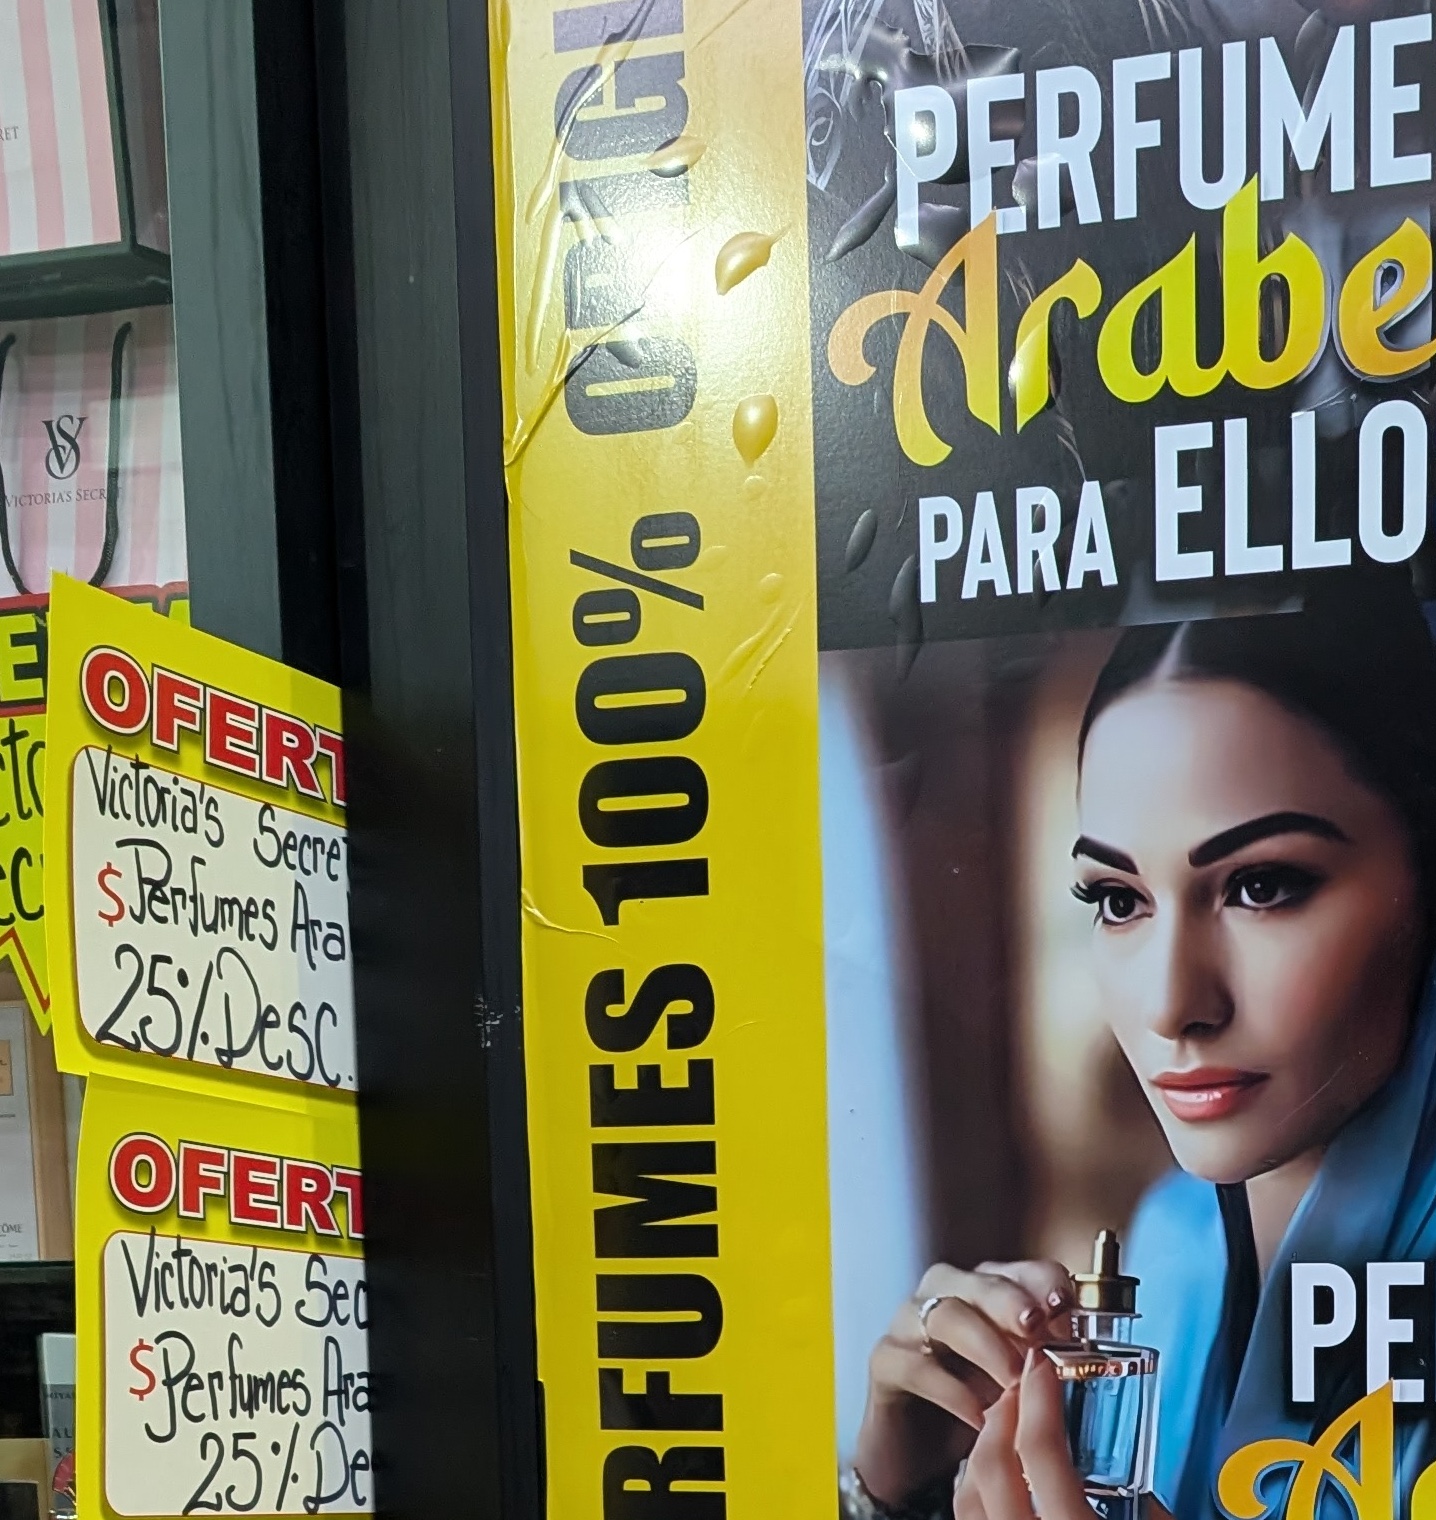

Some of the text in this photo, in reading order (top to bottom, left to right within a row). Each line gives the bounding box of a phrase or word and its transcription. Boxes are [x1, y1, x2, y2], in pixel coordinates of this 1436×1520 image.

[918, 481, 1118, 603] PARA
[570, 511, 710, 926] 100%
[87, 744, 349, 882] Victoria's Secre
[116, 838, 278, 951] Perfumes
[121, 1226, 283, 1329] Victoria's
[144, 1330, 312, 1444] Perfumes
